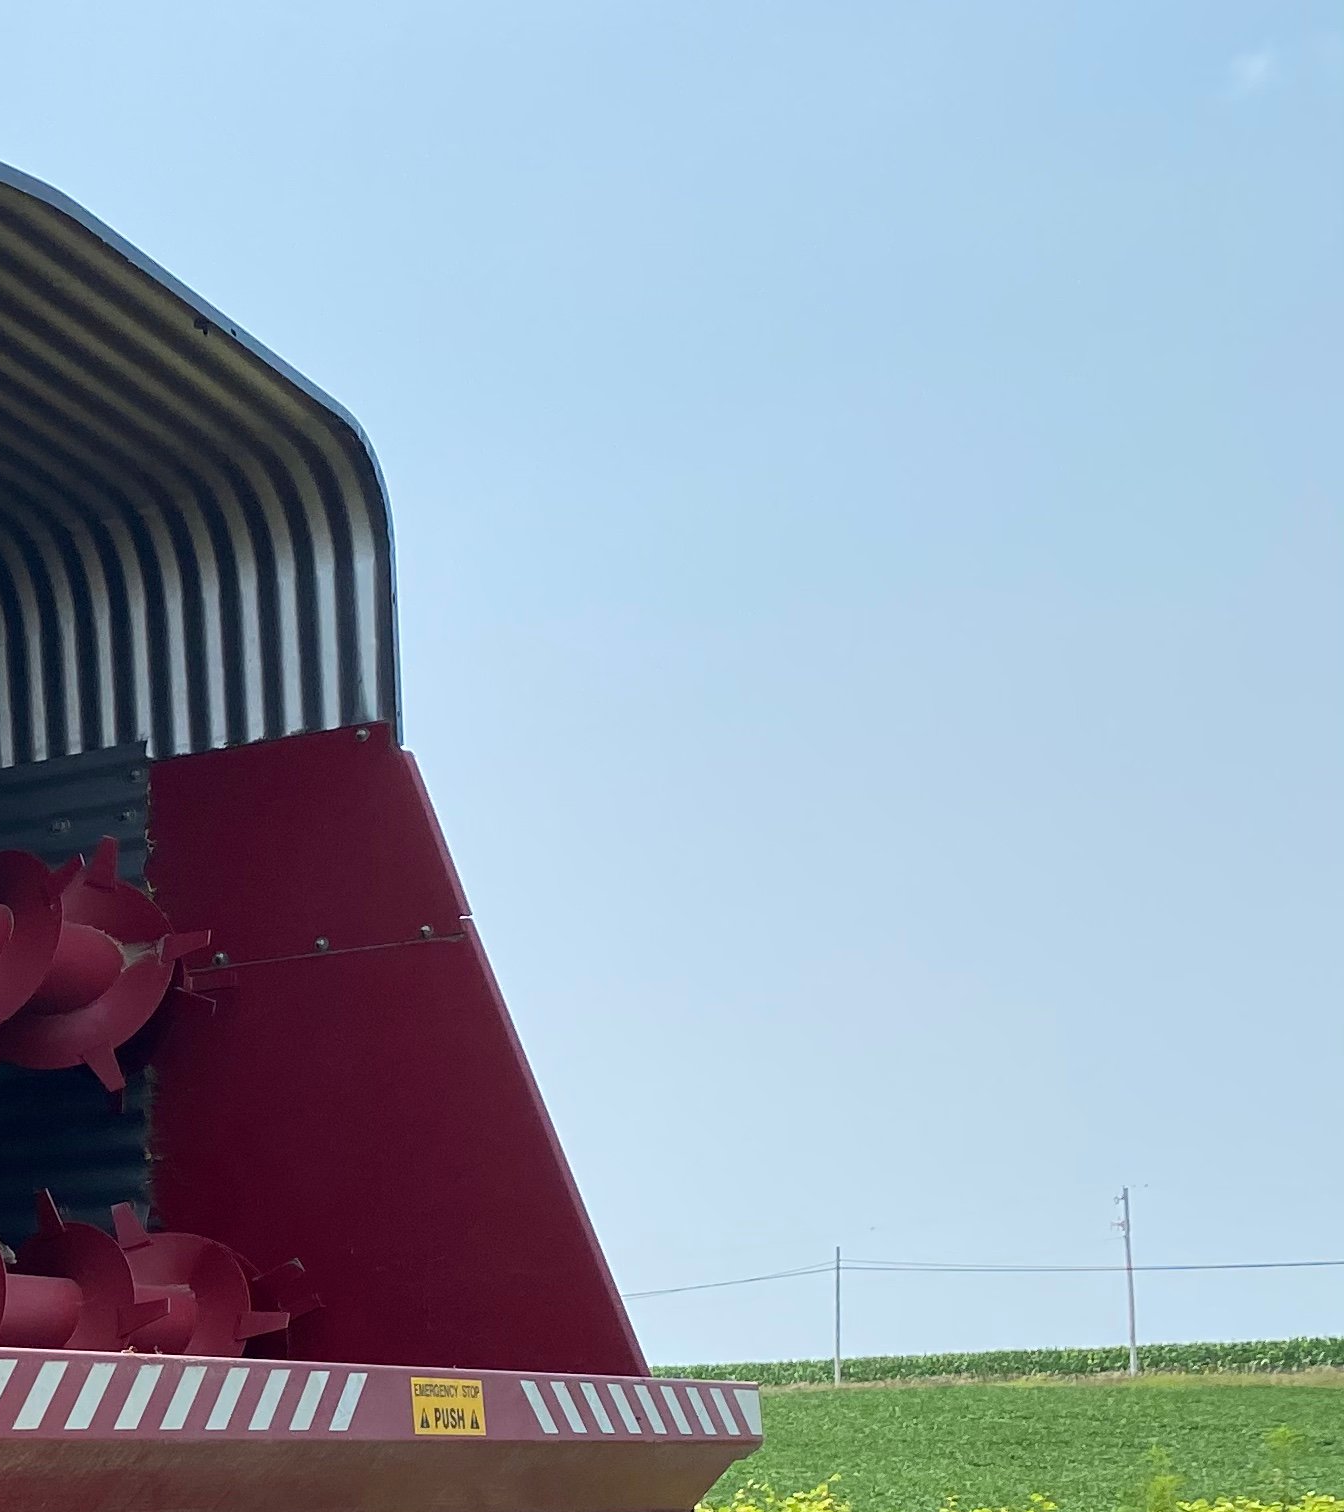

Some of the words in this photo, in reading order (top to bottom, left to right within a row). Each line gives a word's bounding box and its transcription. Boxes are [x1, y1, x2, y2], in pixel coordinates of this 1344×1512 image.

[414, 1383, 458, 1398] EMERGENCY
[462, 1384, 480, 1399] STOP
[434, 1407, 466, 1430] PUSH
